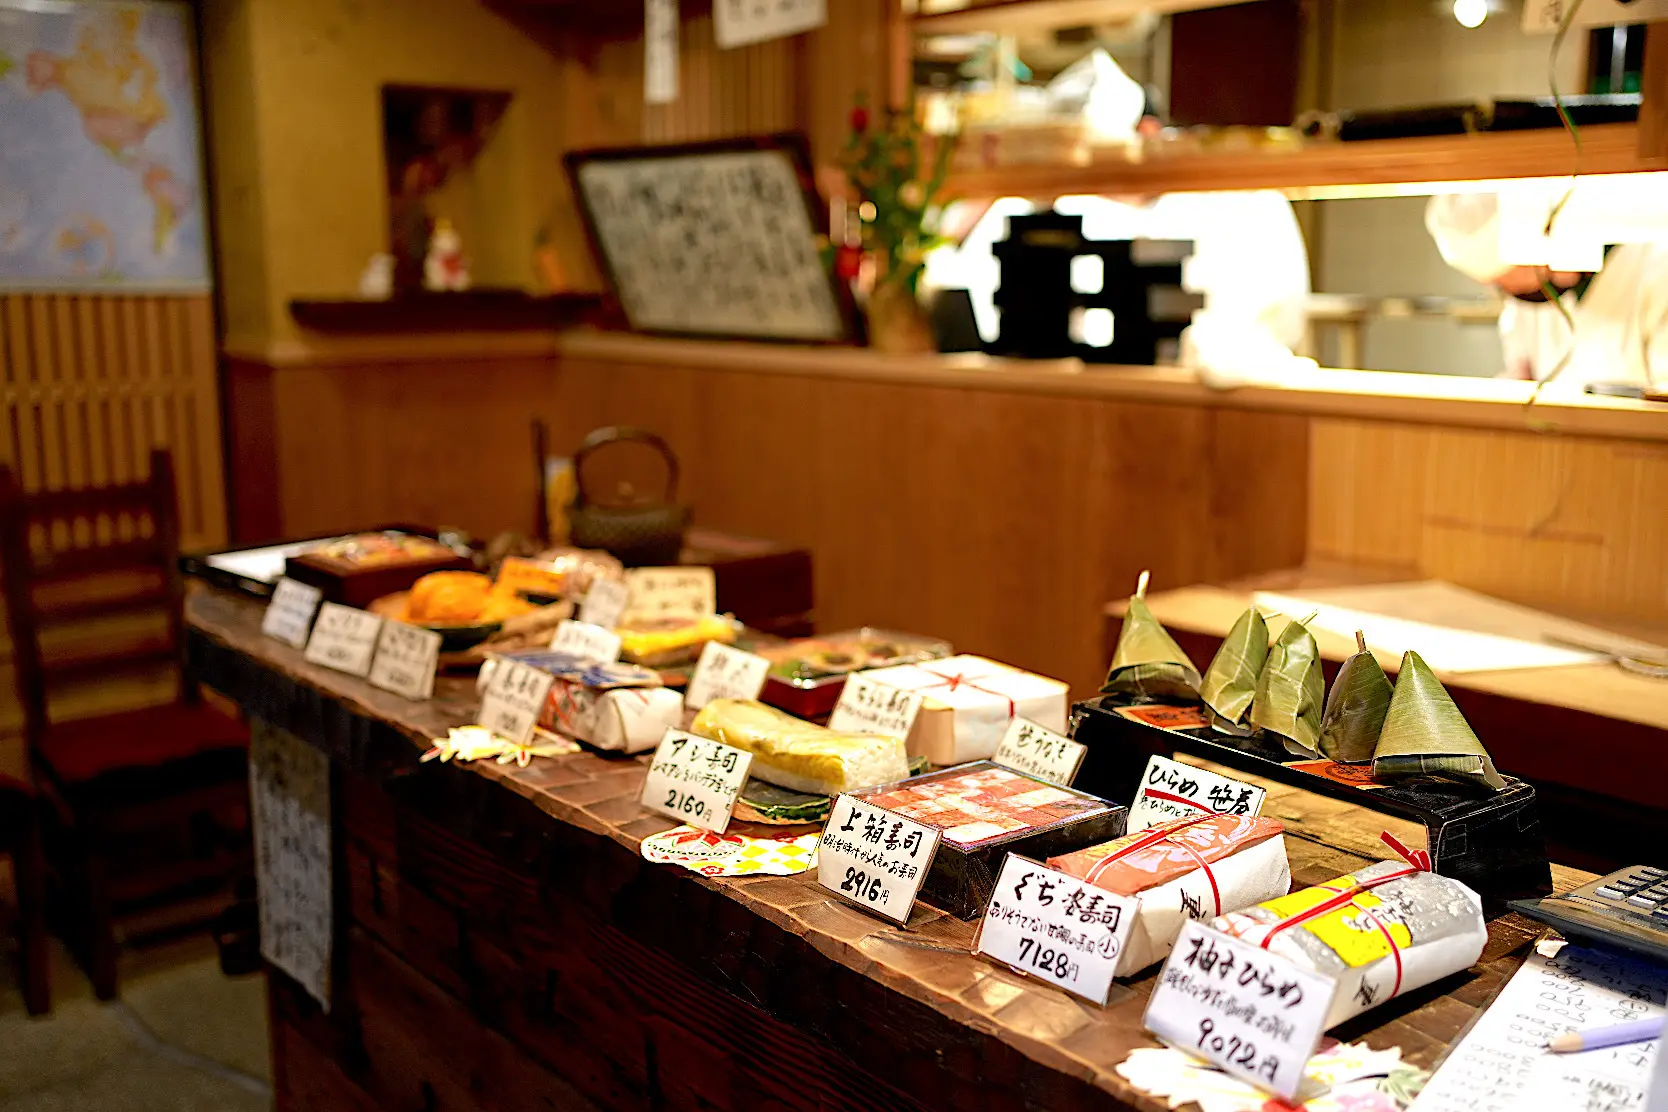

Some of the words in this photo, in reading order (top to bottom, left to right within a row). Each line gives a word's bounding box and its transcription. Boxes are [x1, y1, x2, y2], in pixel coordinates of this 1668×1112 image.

[671, 738, 738, 773] アジ寿司
[1148, 763, 1200, 798] ひらめ
[664, 789, 713, 822] 2160円
[840, 807, 923, 858] 上箱寿司
[840, 867, 890, 906] 2916円
[1018, 937, 1080, 982] 7128円
[1184, 936, 1303, 1009] 柚子ひらめ
[1197, 1017, 1280, 1083] 9072円
